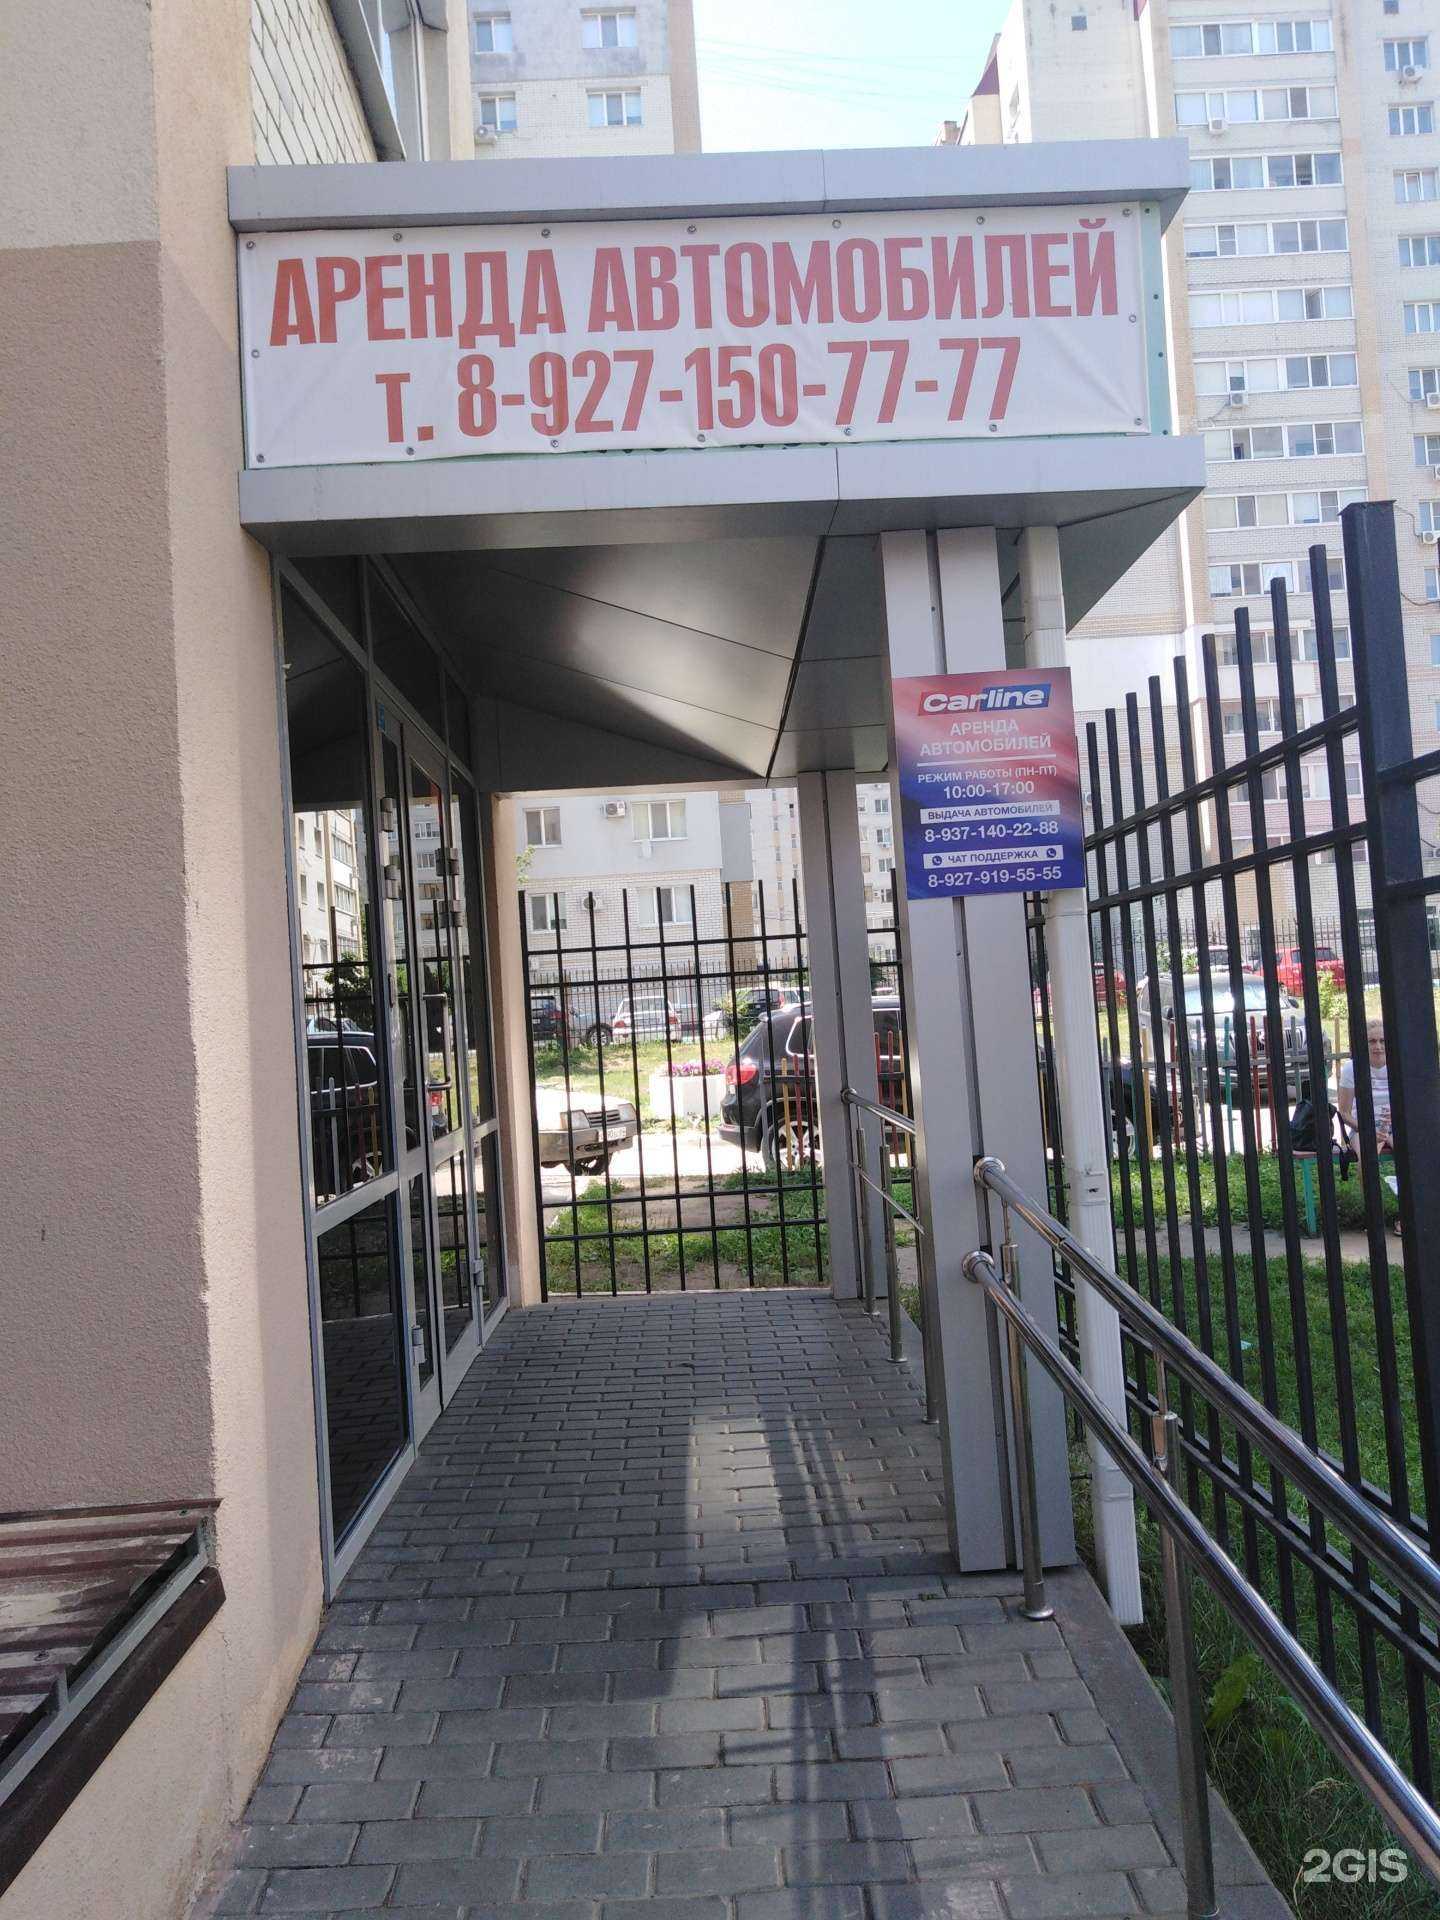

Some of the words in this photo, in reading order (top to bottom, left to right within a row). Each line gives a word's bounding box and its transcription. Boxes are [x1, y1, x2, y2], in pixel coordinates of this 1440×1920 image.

[269, 249, 567, 349] АРЕНДА
[587, 218, 1119, 332] АВТОМОБИЛЕЙ
[375, 372, 434, 443] Т.
[457, 336, 1021, 437] 8-927-150-77-77
[950, 719, 1019, 737] АРЕНДА
[919, 732, 1052, 757] АВТОМОБИЛЕЙ
[917, 772, 962, 784] РЕЖИМ
[965, 767, 1012, 781] РАБОТЫ
[1015, 765, 1057, 777] (ПН-ПТ)
[943, 780, 1035, 800] 10:00-17:00
[928, 809, 972, 821] ВЫДАЧА
[973, 802, 1053, 817] АВТОМОБИЛЕЙ
[924, 820, 1059, 843] 8-937-140-22-88
[947, 854, 968, 864] ЧАТ
[970, 849, 1039, 864] ПОДДЕРЖКА
[928, 866, 1062, 888] 8-927-919-55-55
